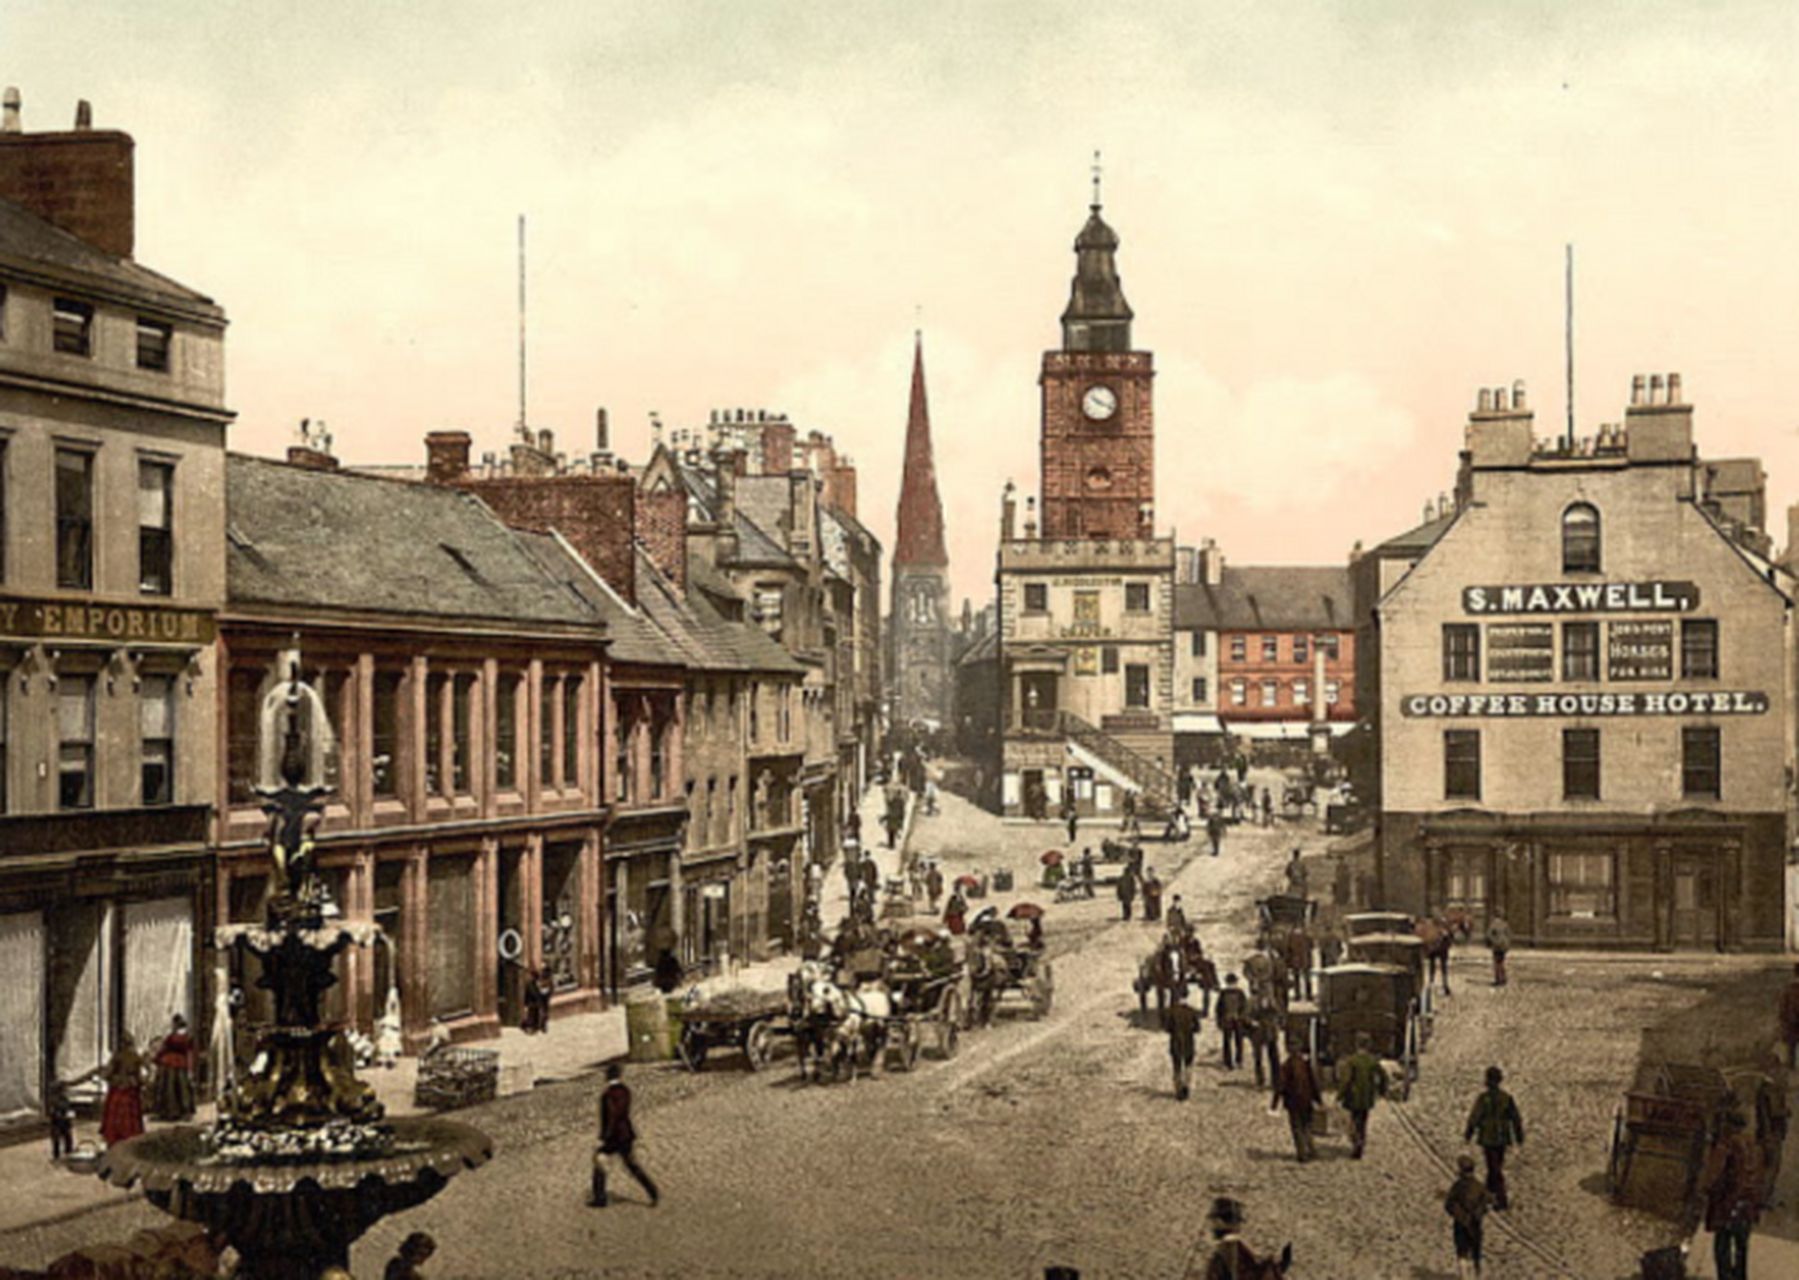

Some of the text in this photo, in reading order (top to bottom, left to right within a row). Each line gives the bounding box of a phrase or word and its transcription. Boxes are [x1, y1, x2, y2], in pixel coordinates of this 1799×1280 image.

[43, 605, 199, 638] EMPORIUM
[1409, 692, 1764, 714] COFFEE HOUSE HOTEL.
